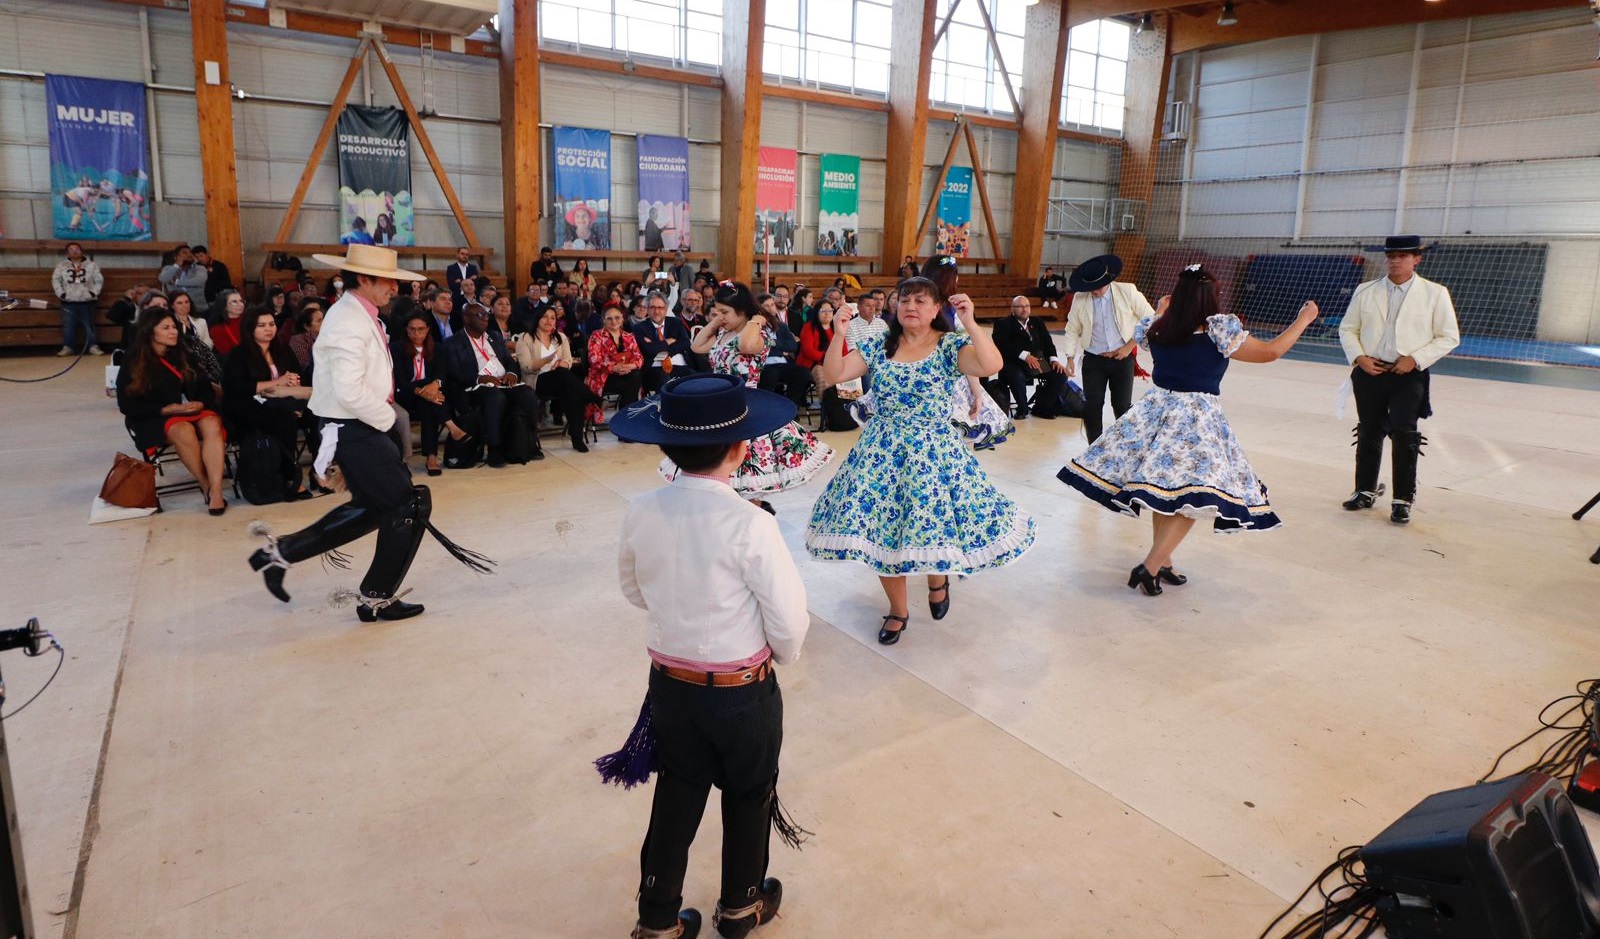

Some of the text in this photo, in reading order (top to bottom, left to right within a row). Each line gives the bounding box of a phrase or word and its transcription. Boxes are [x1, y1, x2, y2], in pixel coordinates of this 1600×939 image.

[57, 105, 135, 127] MUJER
[340, 135, 406, 148] DESARROLLO
[340, 145, 406, 157] PRODUCTIVO
[557, 147, 607, 158] PROTECCIÓN
[557, 155, 607, 169] SOCIAL
[639, 155, 686, 164] PARTICIPACIÓN
[639, 163, 687, 172] CIUDADANA
[758, 166, 795, 175] ISCAPACIDAD
[824, 171, 855, 182] MEDIO
[823, 181, 856, 190] AMBIENTE
[947, 182, 968, 193] 2022
[67, 269, 86, 283] 32
